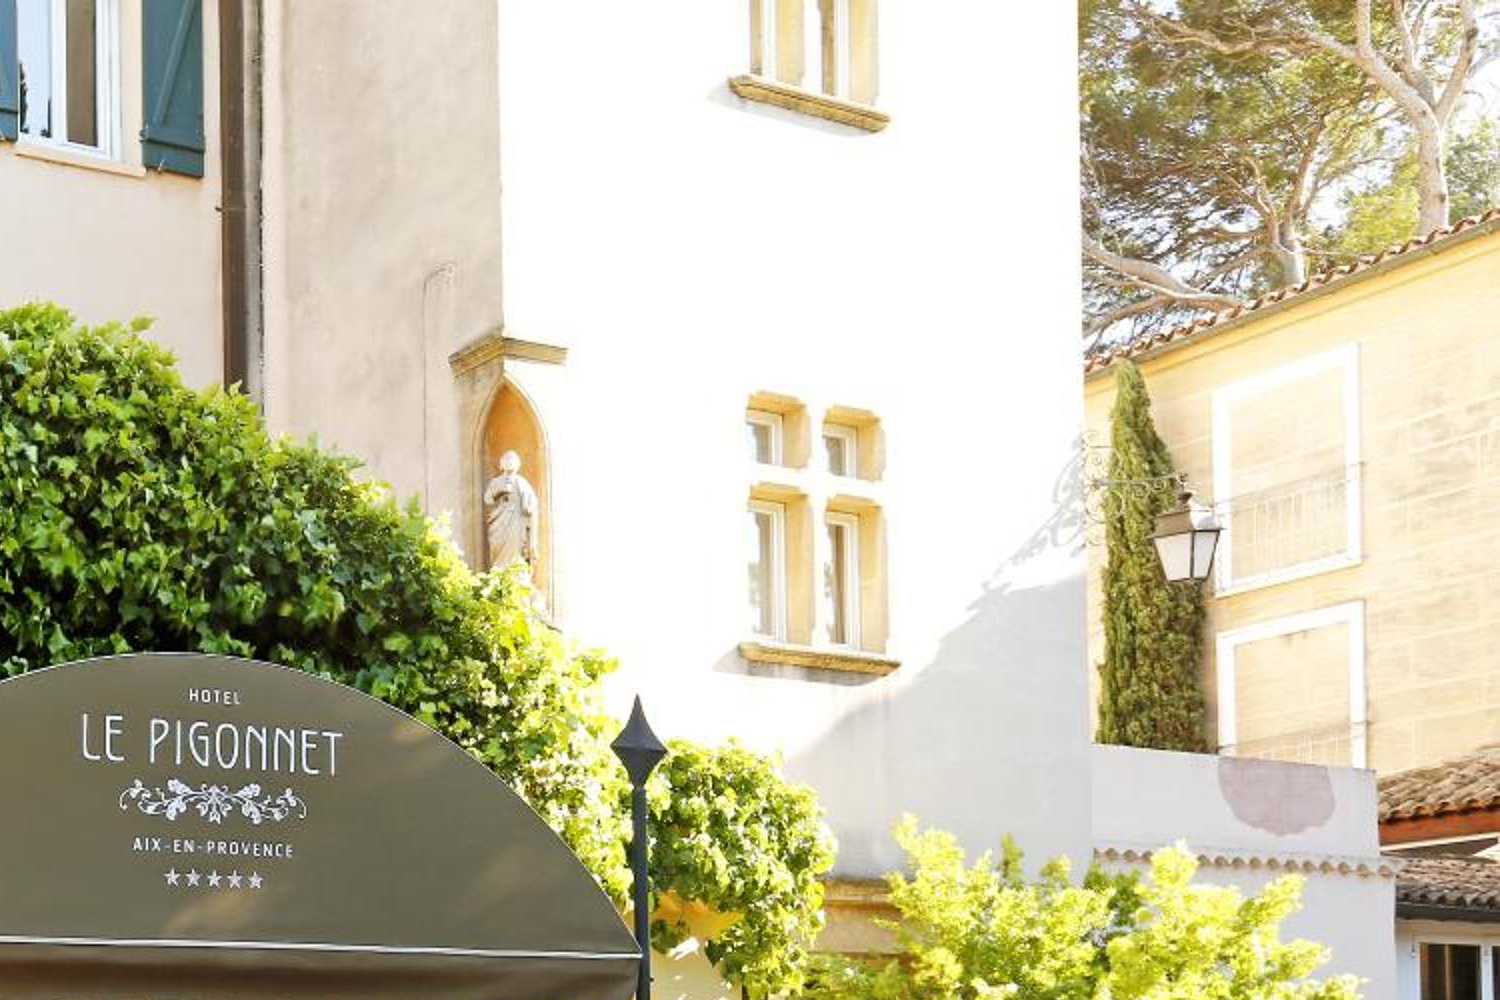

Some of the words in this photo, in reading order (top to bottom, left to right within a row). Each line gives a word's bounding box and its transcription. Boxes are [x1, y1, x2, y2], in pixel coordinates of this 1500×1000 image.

[188, 688, 241, 705] HOTEL
[82, 713, 125, 761] LE
[149, 718, 344, 776] PIGONNET
